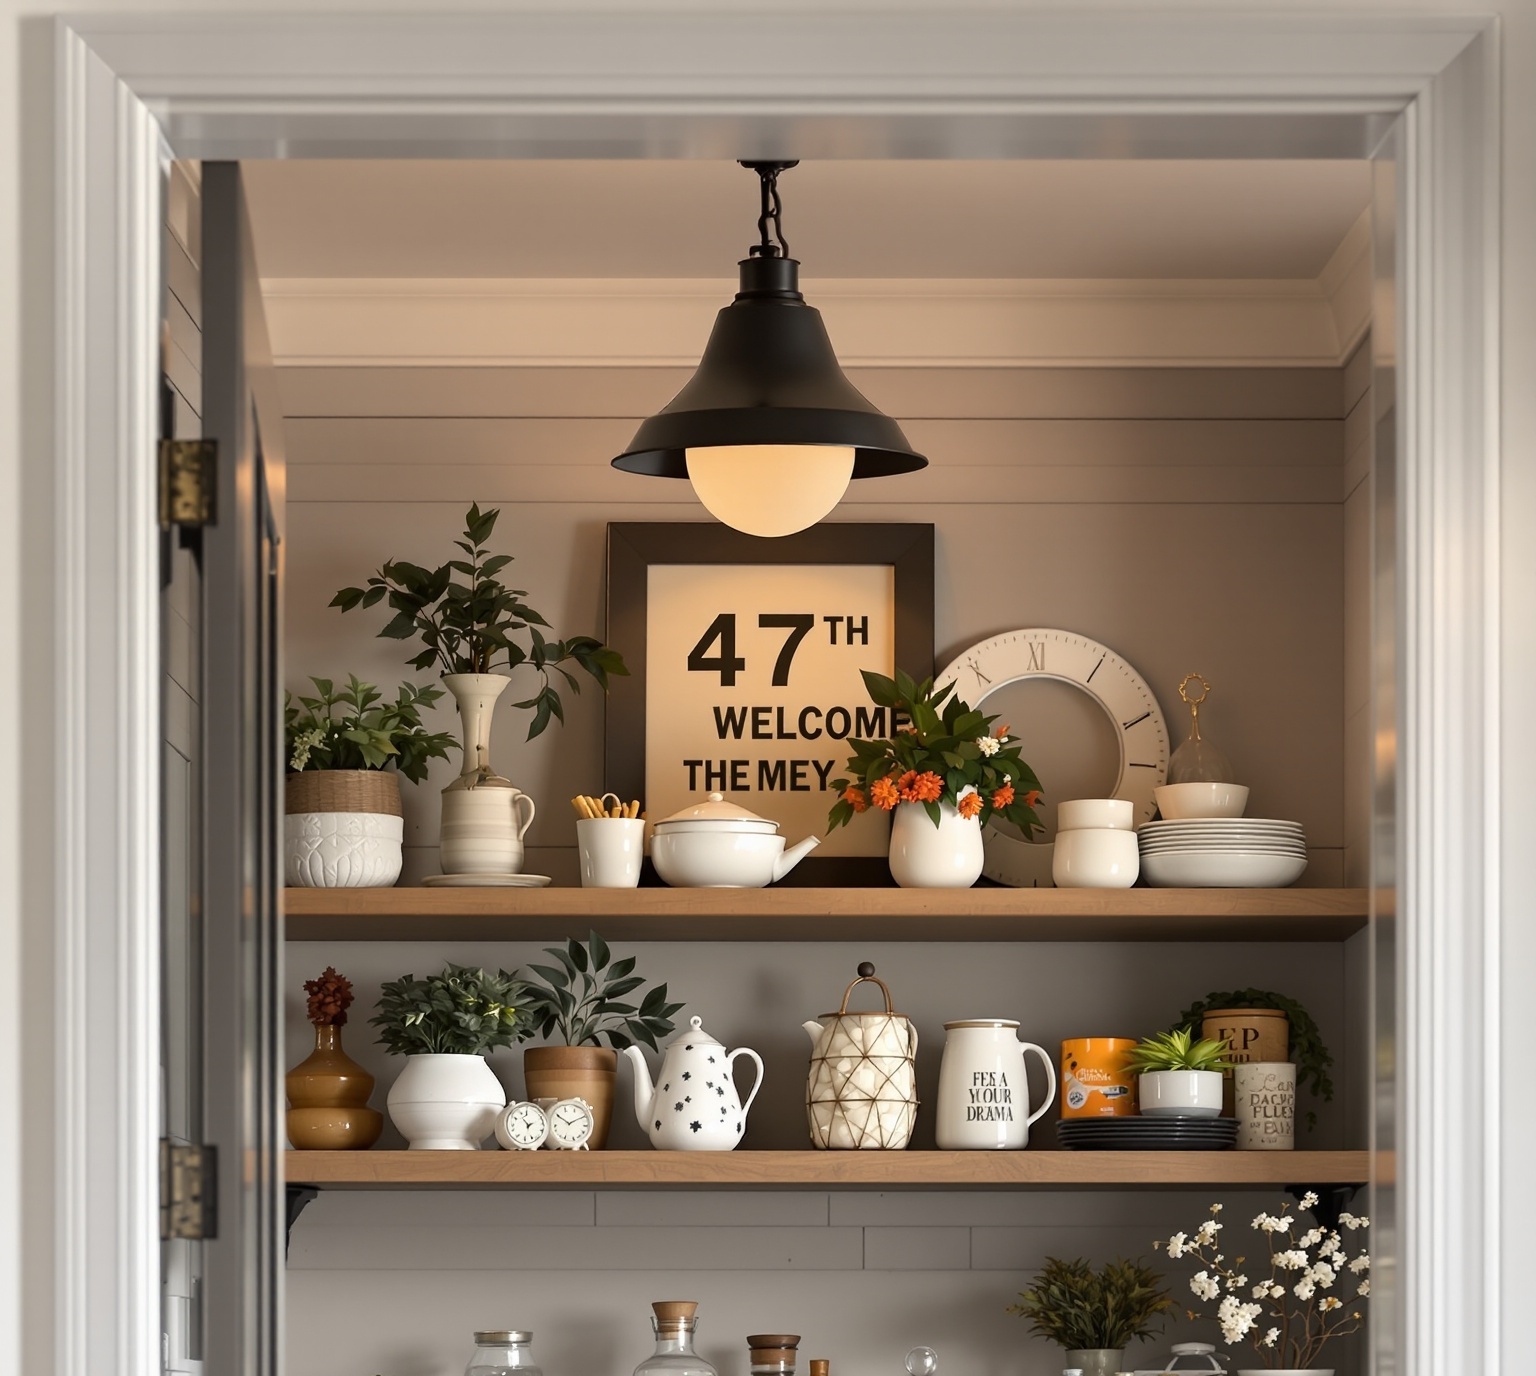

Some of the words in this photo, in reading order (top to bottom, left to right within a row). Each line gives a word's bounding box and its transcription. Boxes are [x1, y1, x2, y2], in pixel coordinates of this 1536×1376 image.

[683, 759, 751, 792] THE
[758, 759, 836, 792] MEY
[966, 1105, 1014, 1122] DRAMA
